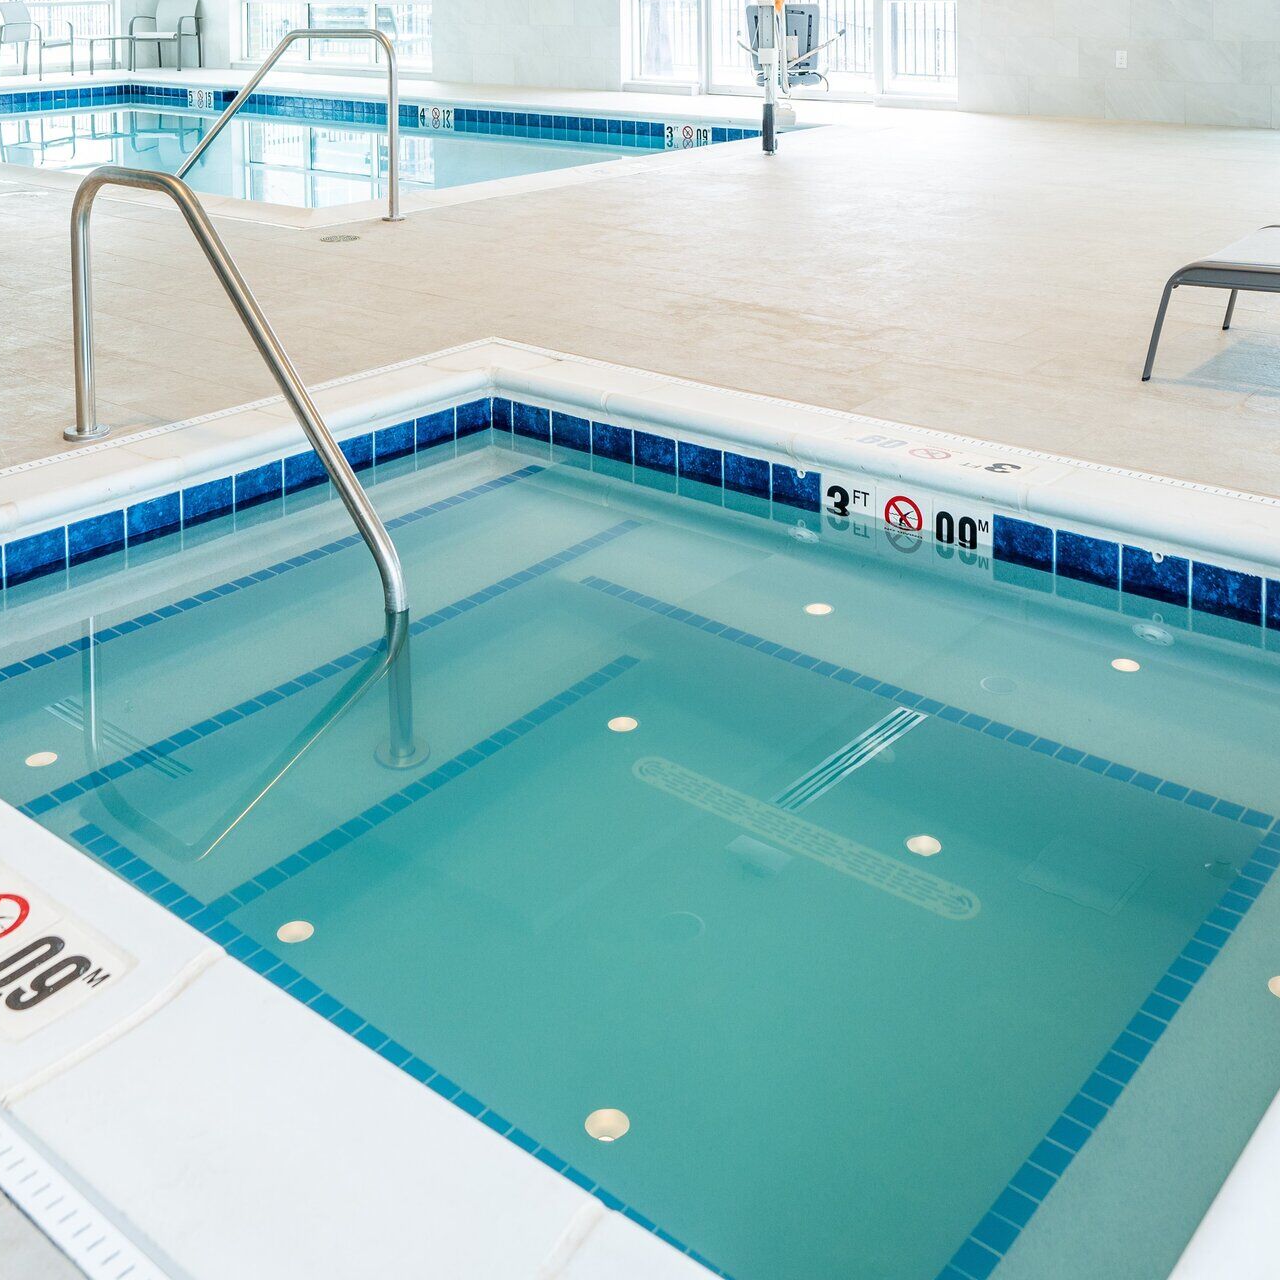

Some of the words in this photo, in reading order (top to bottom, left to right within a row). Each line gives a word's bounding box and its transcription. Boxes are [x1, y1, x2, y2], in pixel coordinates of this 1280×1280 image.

[666, 126, 673, 138] 3
[827, 485, 849, 516] 3
[853, 490, 869, 507] FT
[978, 520, 988, 533] M
[82, 967, 111, 988] M
